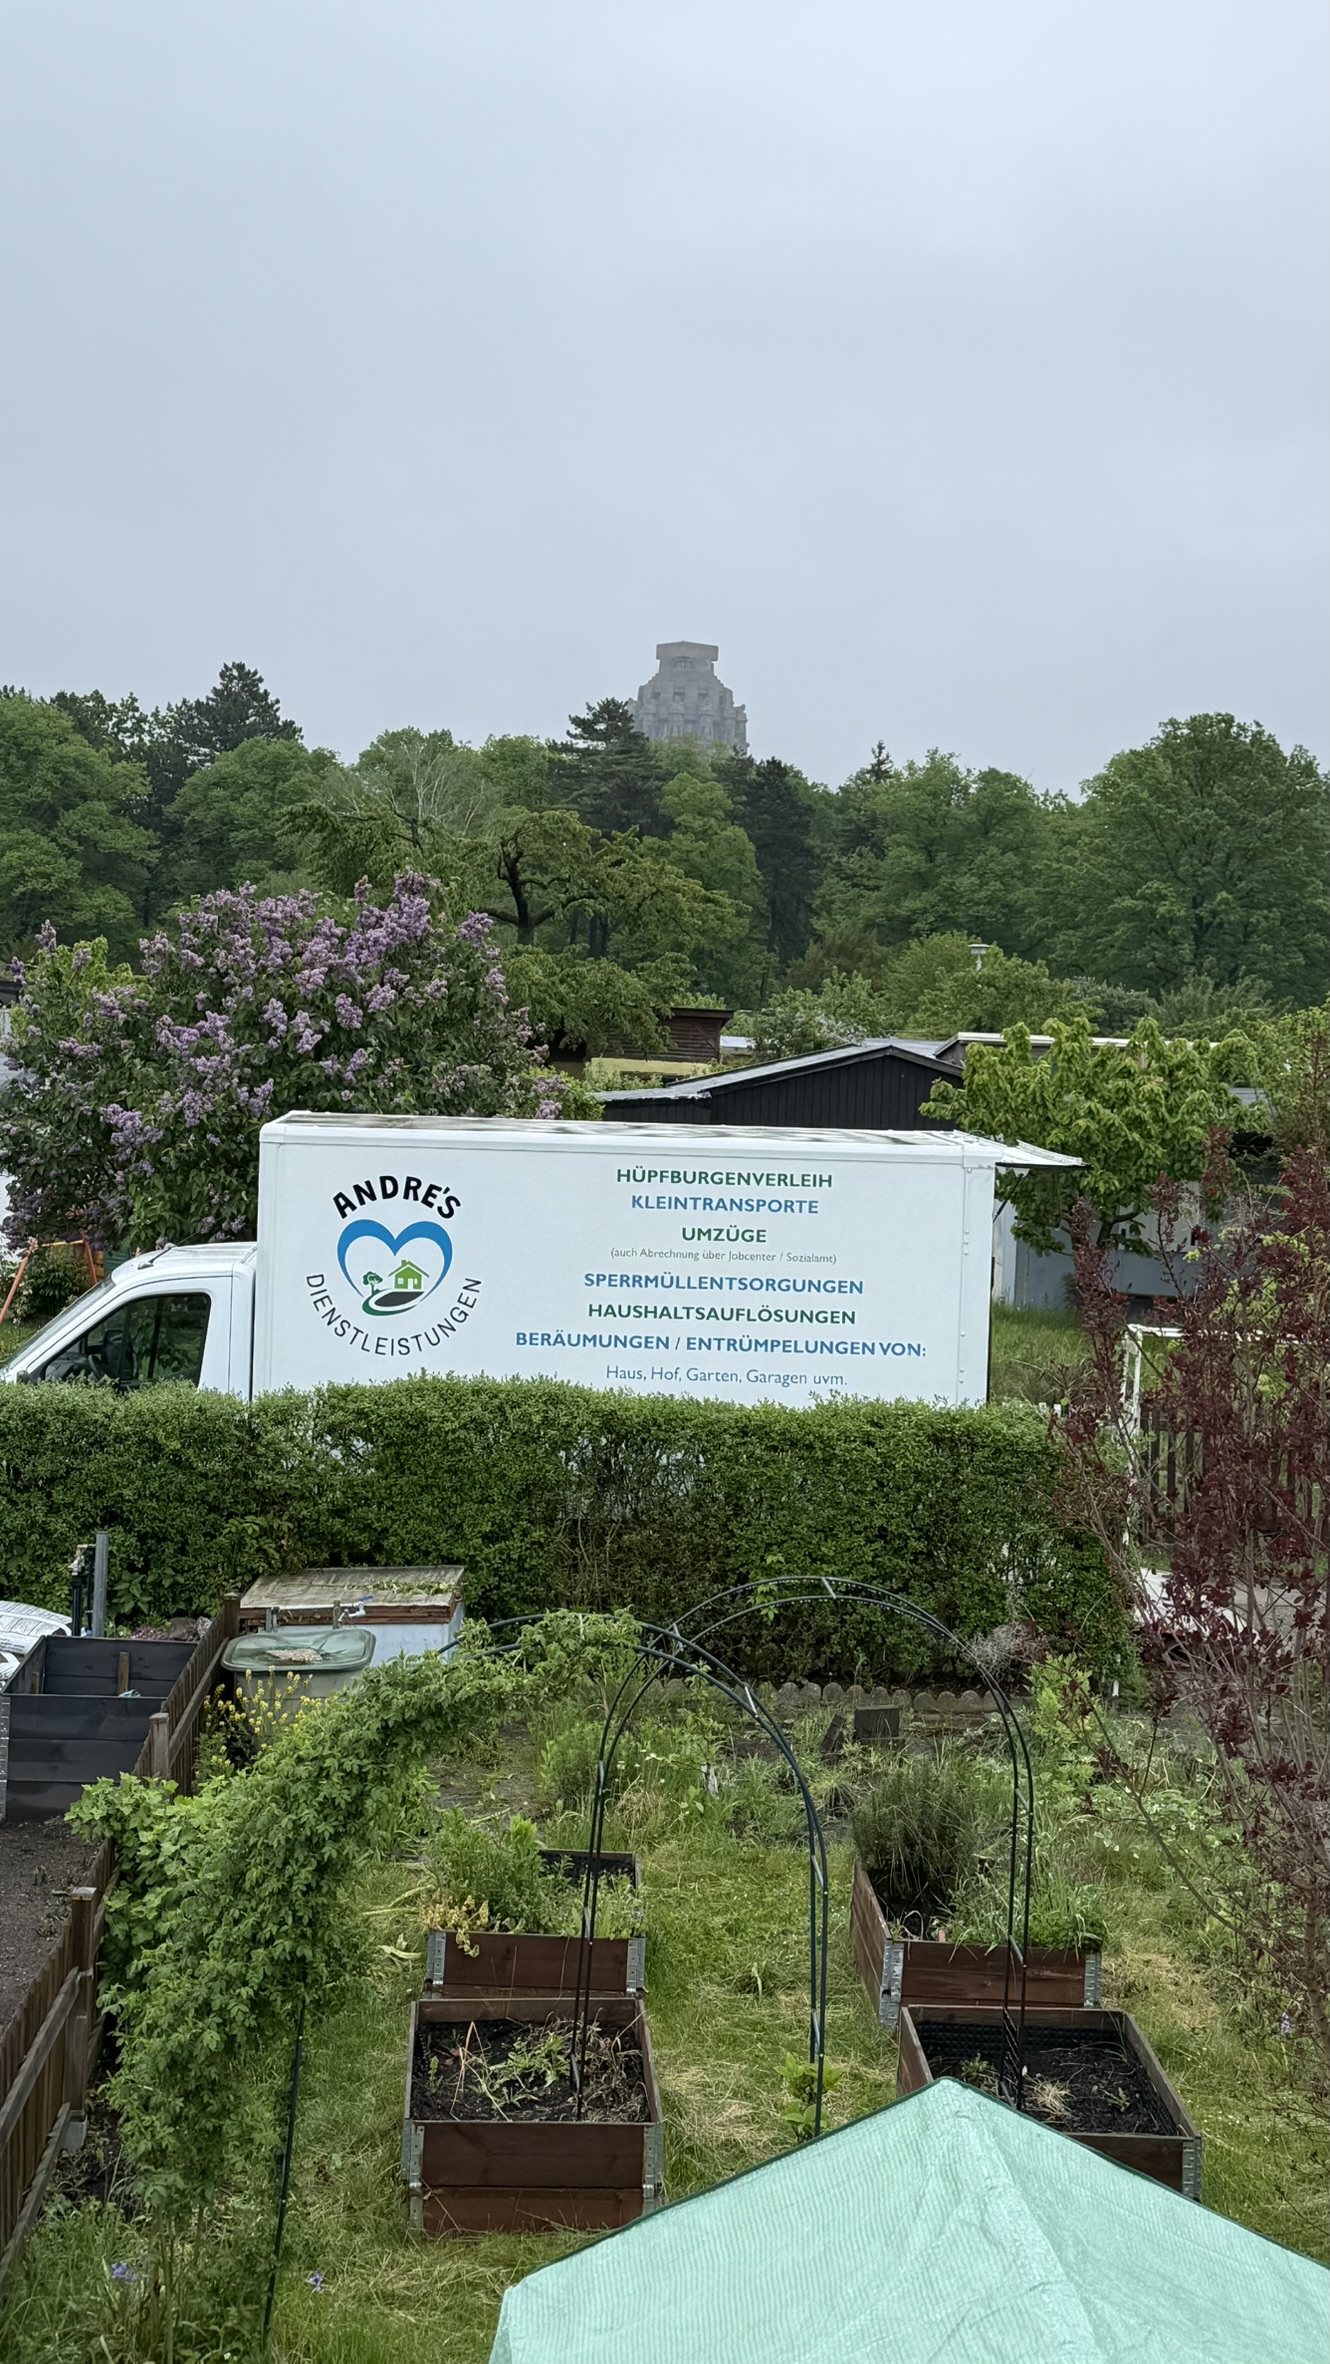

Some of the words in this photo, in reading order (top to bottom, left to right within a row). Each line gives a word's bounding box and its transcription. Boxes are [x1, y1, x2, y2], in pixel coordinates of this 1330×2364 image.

[616, 1166, 832, 1187] HÜPFBURGENVERLEIH
[333, 1175, 461, 1219] ANDRE'S
[631, 1195, 818, 1214] KLEINTRANSPORTE
[681, 1225, 766, 1242] UMZÜGE
[610, 1248, 637, 1258] (auch
[639, 1248, 699, 1261] Abrechnung
[702, 1250, 725, 1259] über
[727, 1251, 776, 1262] Jobcenter
[786, 1252, 836, 1265] Sozialamt)
[584, 1272, 863, 1294] SPERRMÜLLENTSORGUNGEN
[306, 1273, 483, 1357] DIENSTLEISTUNGEN
[588, 1304, 855, 1324] HAUSHALTSAUFLÖSUNGEN
[515, 1330, 669, 1349] BERÄUMUNGEN
[674, 1336, 681, 1351] /
[686, 1335, 875, 1355] ENTRÜMPELUNGEN
[878, 1342, 926, 1356] VON:
[606, 1365, 646, 1381] Haus,
[650, 1367, 681, 1382] Hof,
[685, 1368, 741, 1383] Garten,
[745, 1369, 807, 1388] Garagen
[813, 1375, 848, 1386] uvm.
